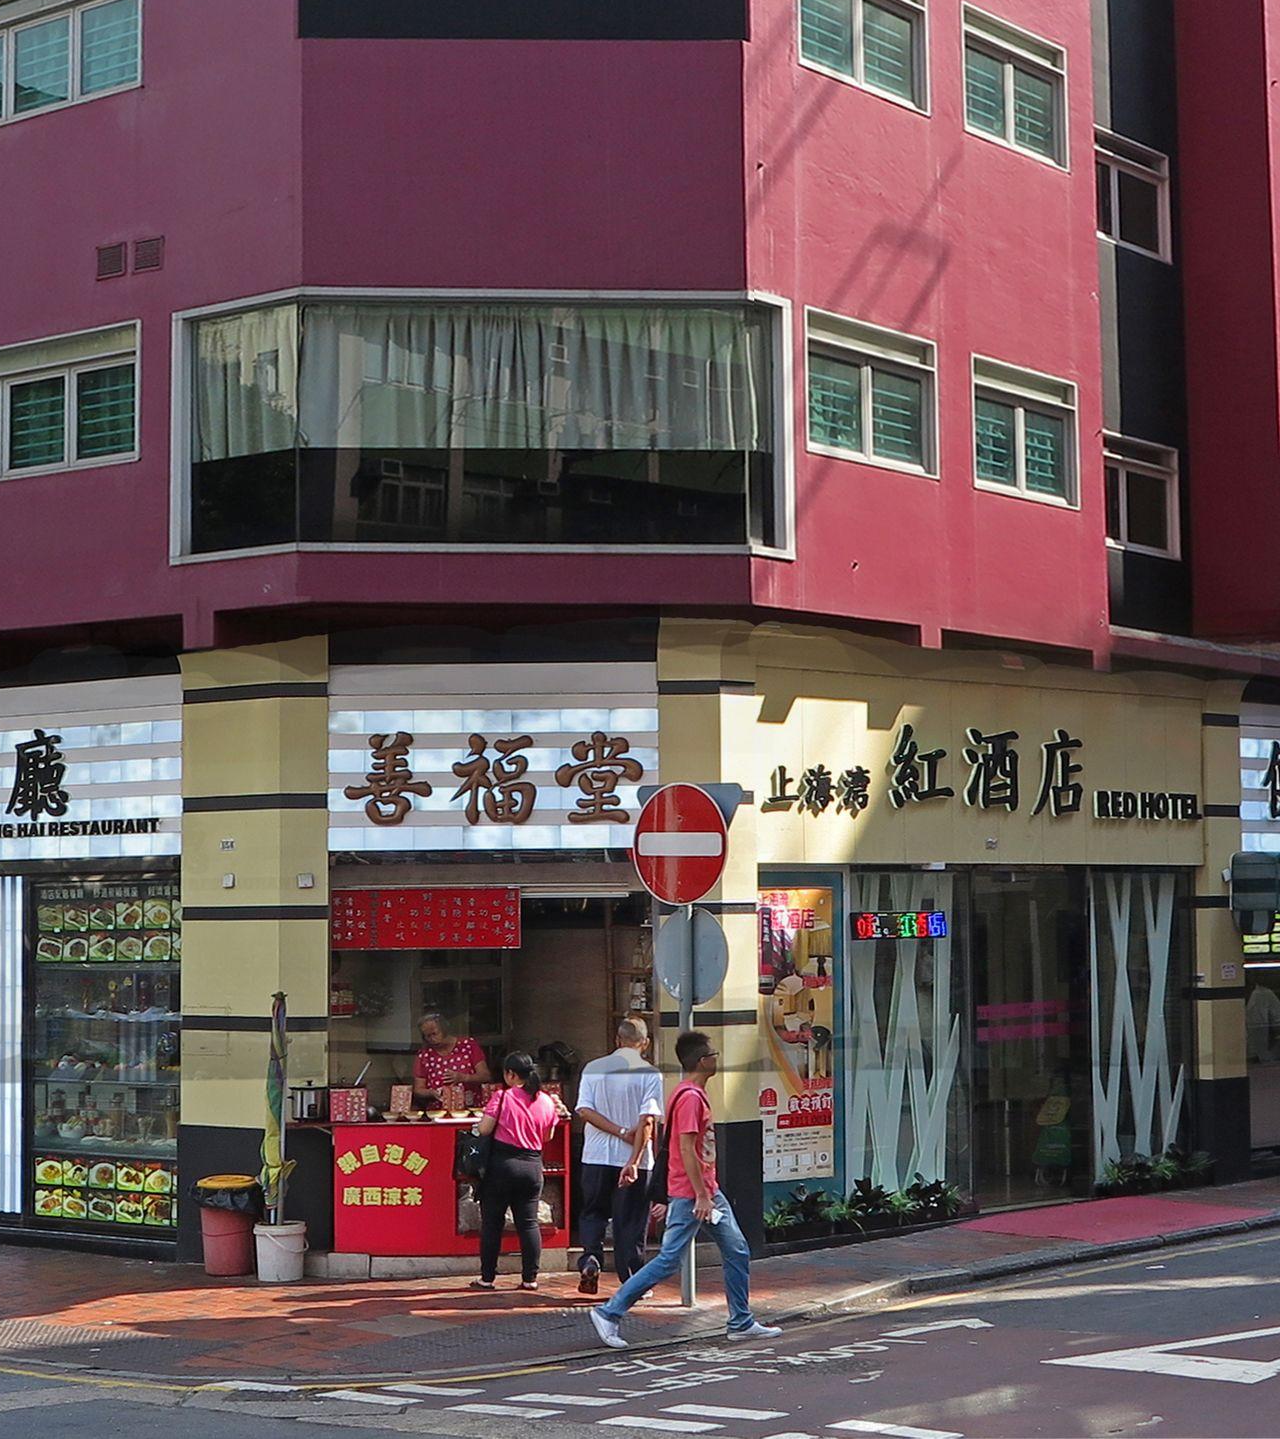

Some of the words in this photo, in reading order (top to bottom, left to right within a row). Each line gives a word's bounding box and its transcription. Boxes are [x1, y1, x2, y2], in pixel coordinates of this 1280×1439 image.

[343, 730, 644, 827] 善福堂
[888, 722, 1084, 818] 紅酒店
[1095, 790, 1136, 819] RED
[1138, 792, 1203, 820] HOTEL
[17, 822, 47, 839] HAI
[48, 817, 161, 837] RESTAURANT
[342, 1186, 423, 1207] 廣西涼茶
[754, 1337, 927, 1366] LOOK
[597, 1366, 781, 1398] LEFT
